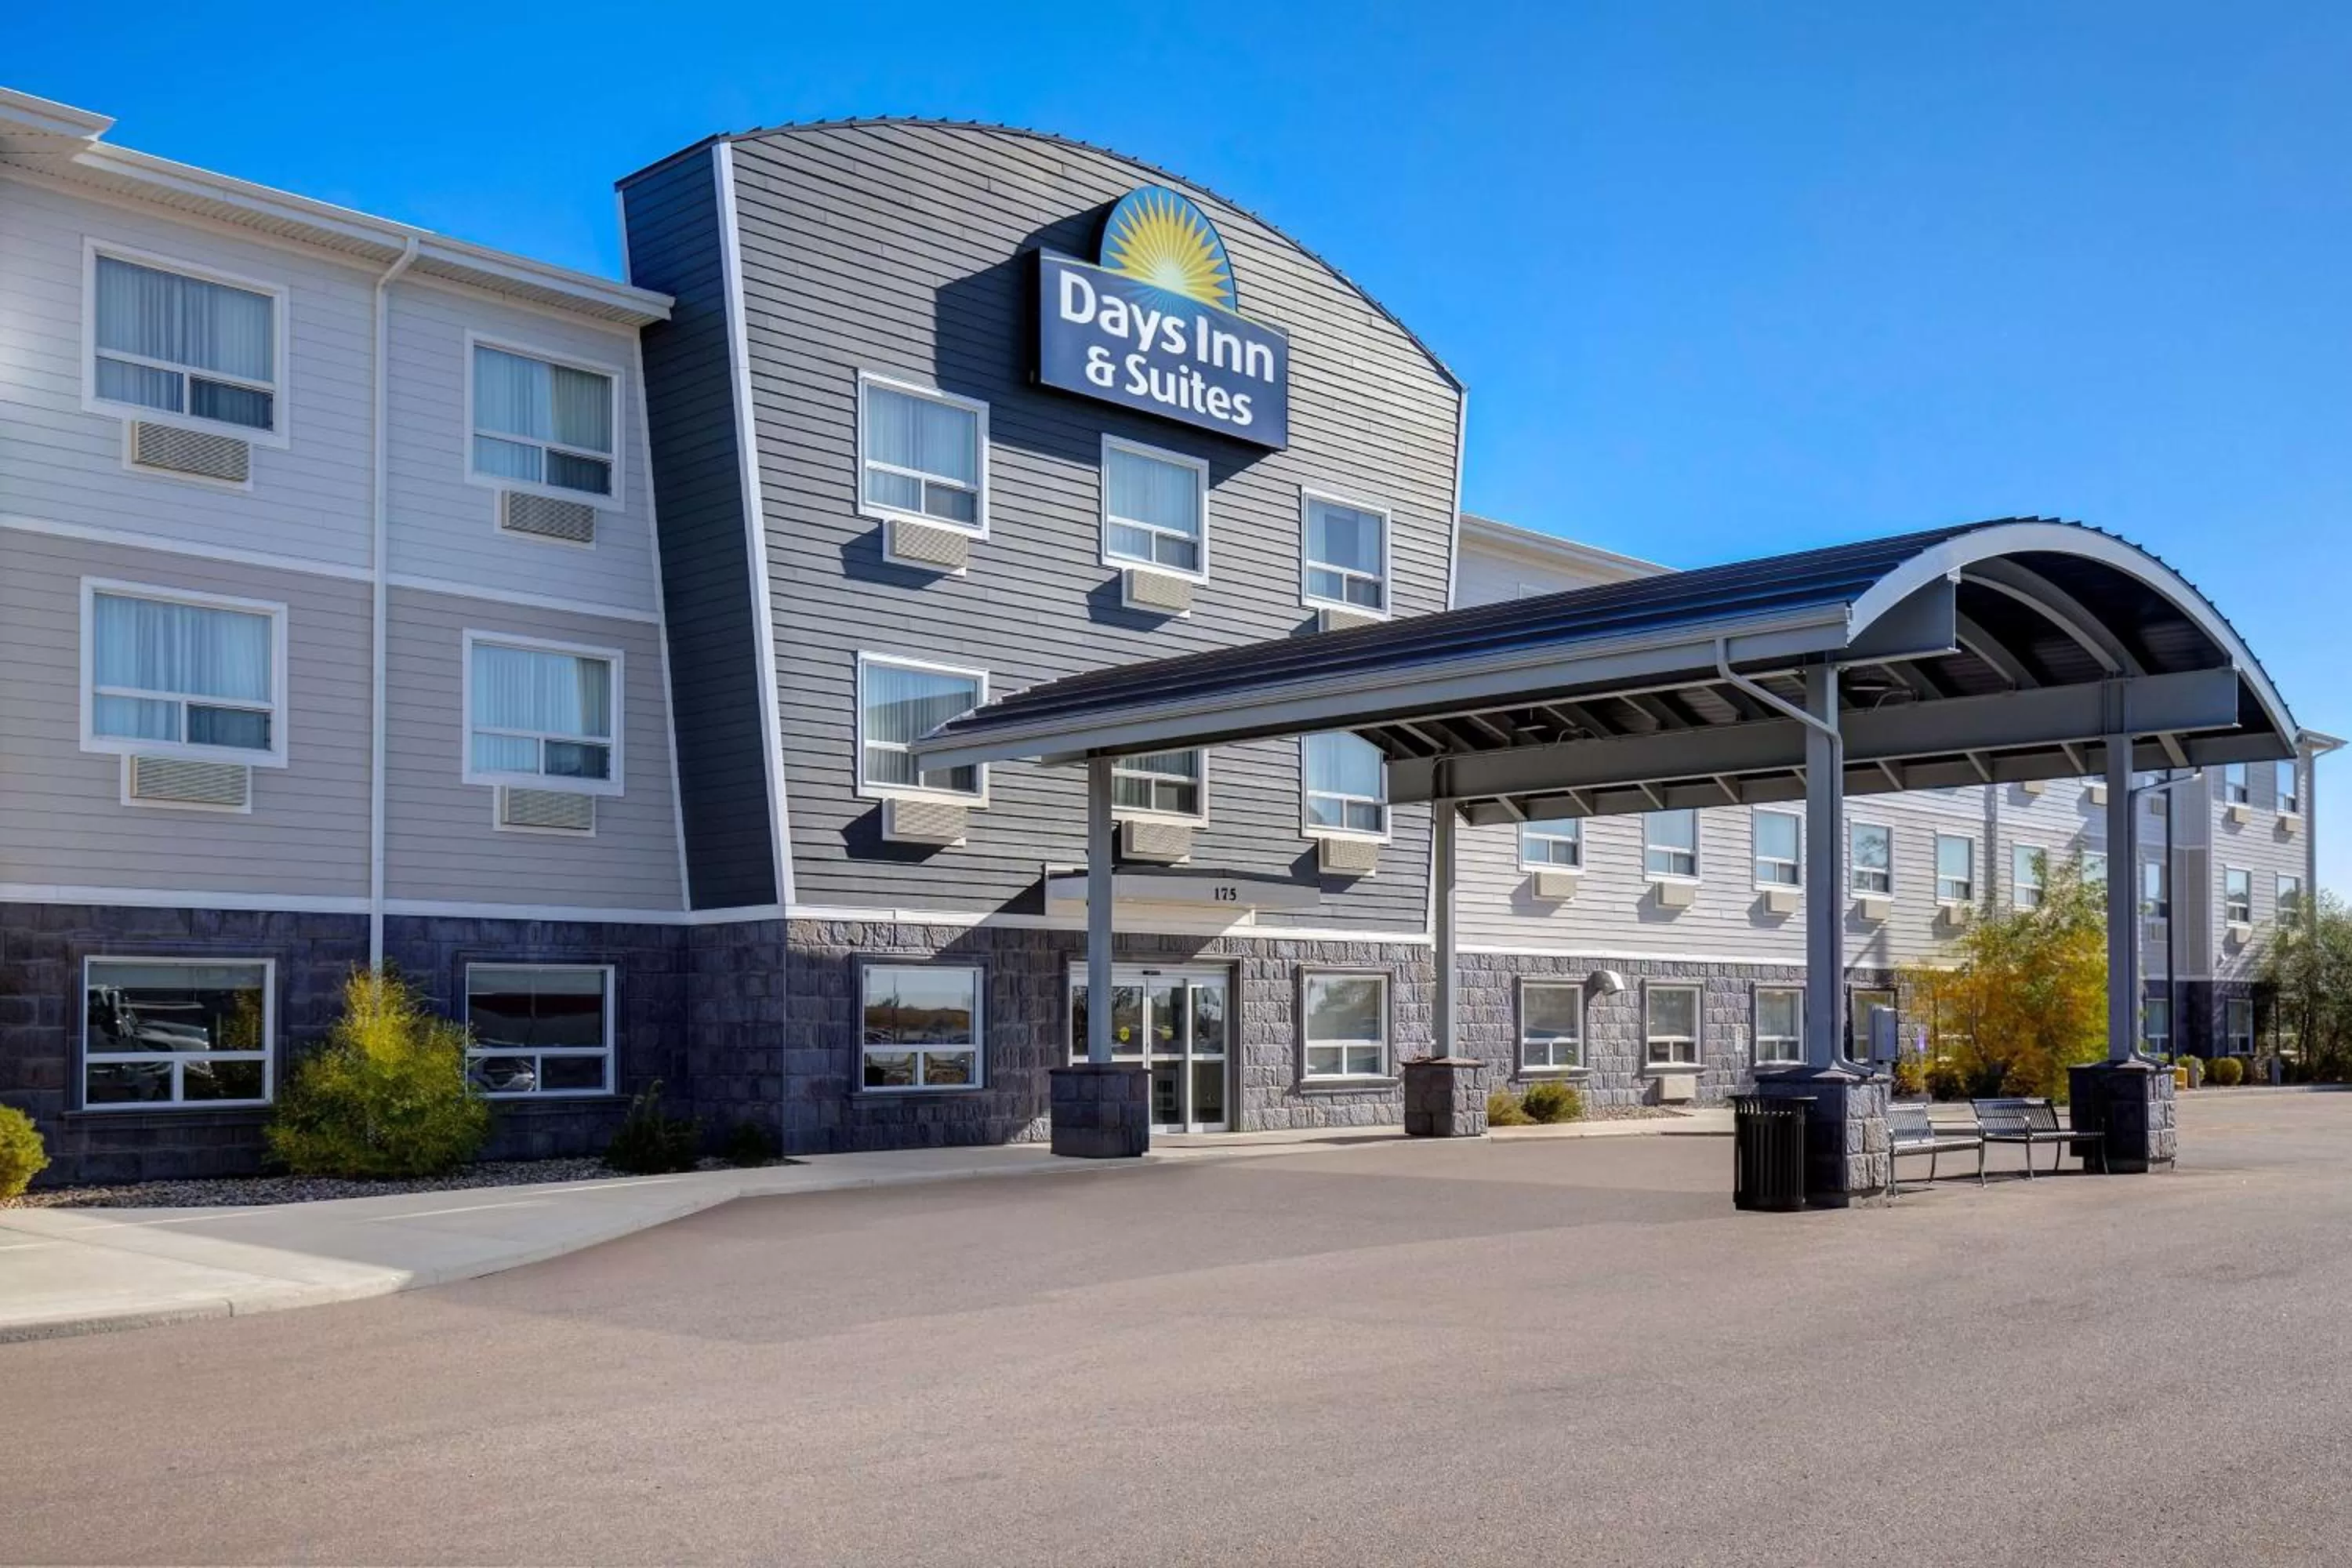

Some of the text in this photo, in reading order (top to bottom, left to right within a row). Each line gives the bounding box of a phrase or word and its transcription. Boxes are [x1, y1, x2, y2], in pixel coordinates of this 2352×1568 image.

[1060, 269, 1275, 383] Days Inn
[1085, 345, 1254, 426] & Suites
[1214, 887, 1236, 901] 175
